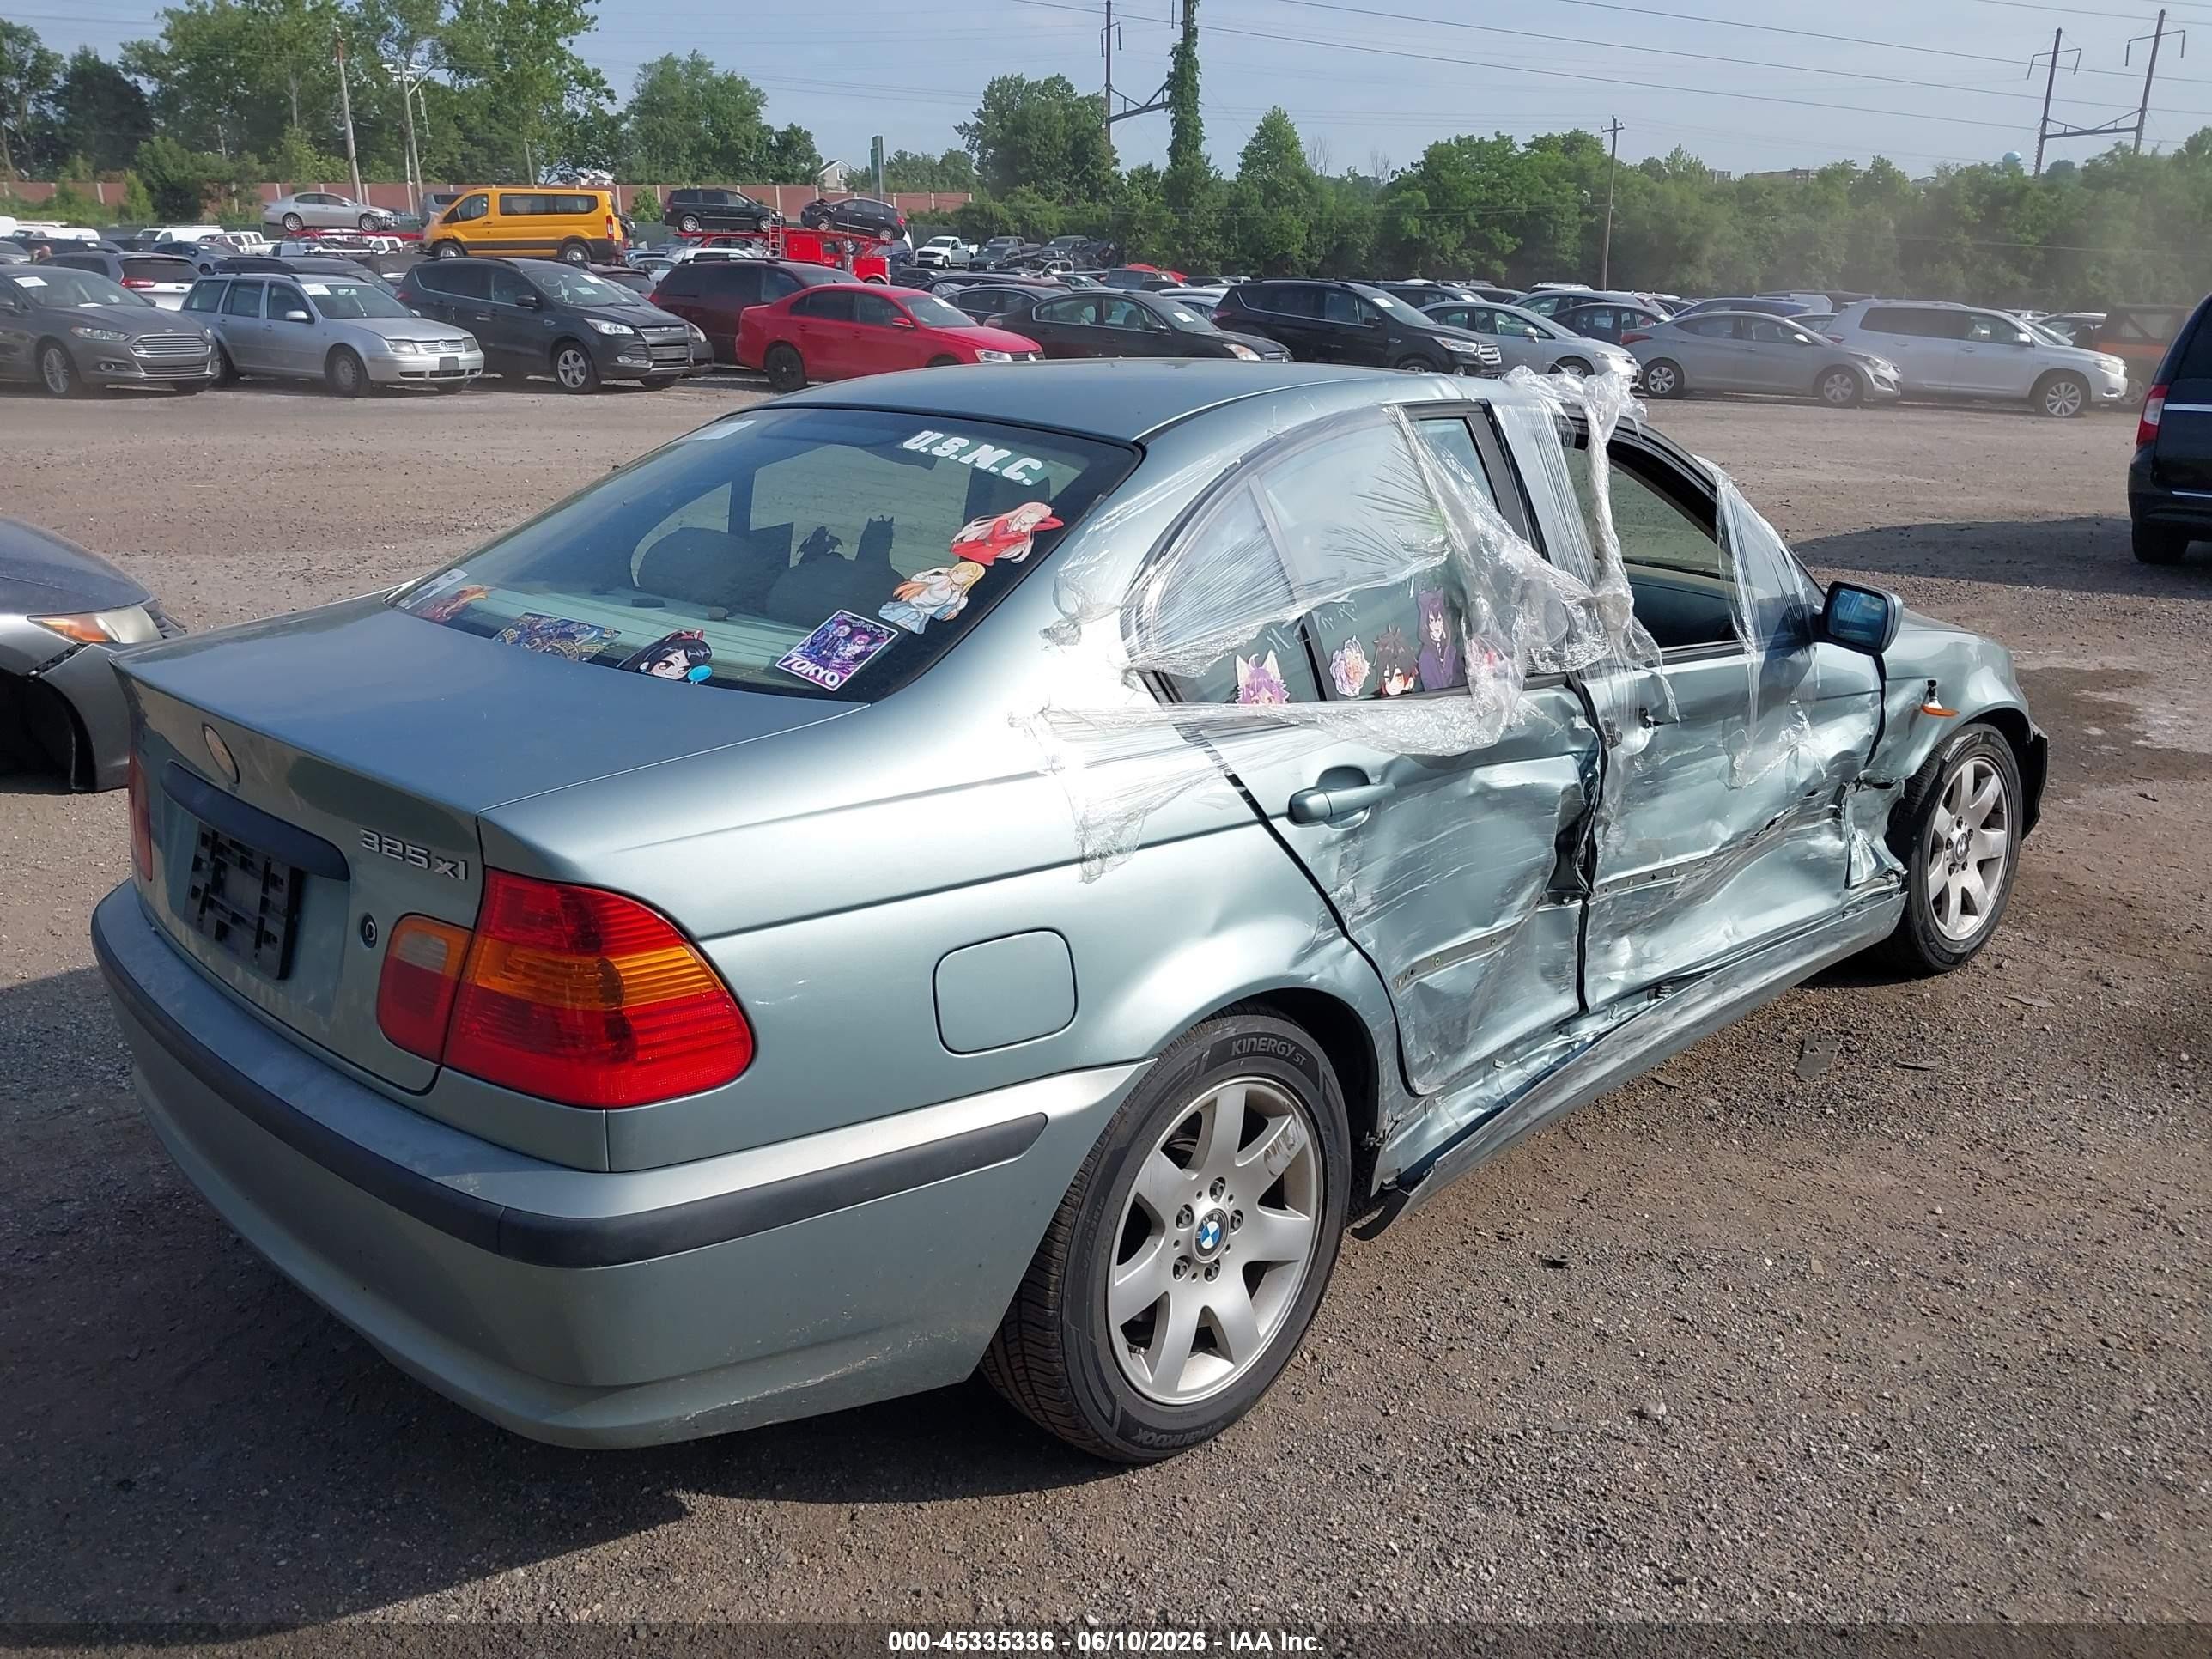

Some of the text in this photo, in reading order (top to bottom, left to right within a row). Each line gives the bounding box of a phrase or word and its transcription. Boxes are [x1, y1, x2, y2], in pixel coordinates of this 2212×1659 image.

[903, 430, 1043, 486] U.S.M.C.
[781, 659, 840, 686] TOKYO
[1293, 1052, 1308, 1066] ST
